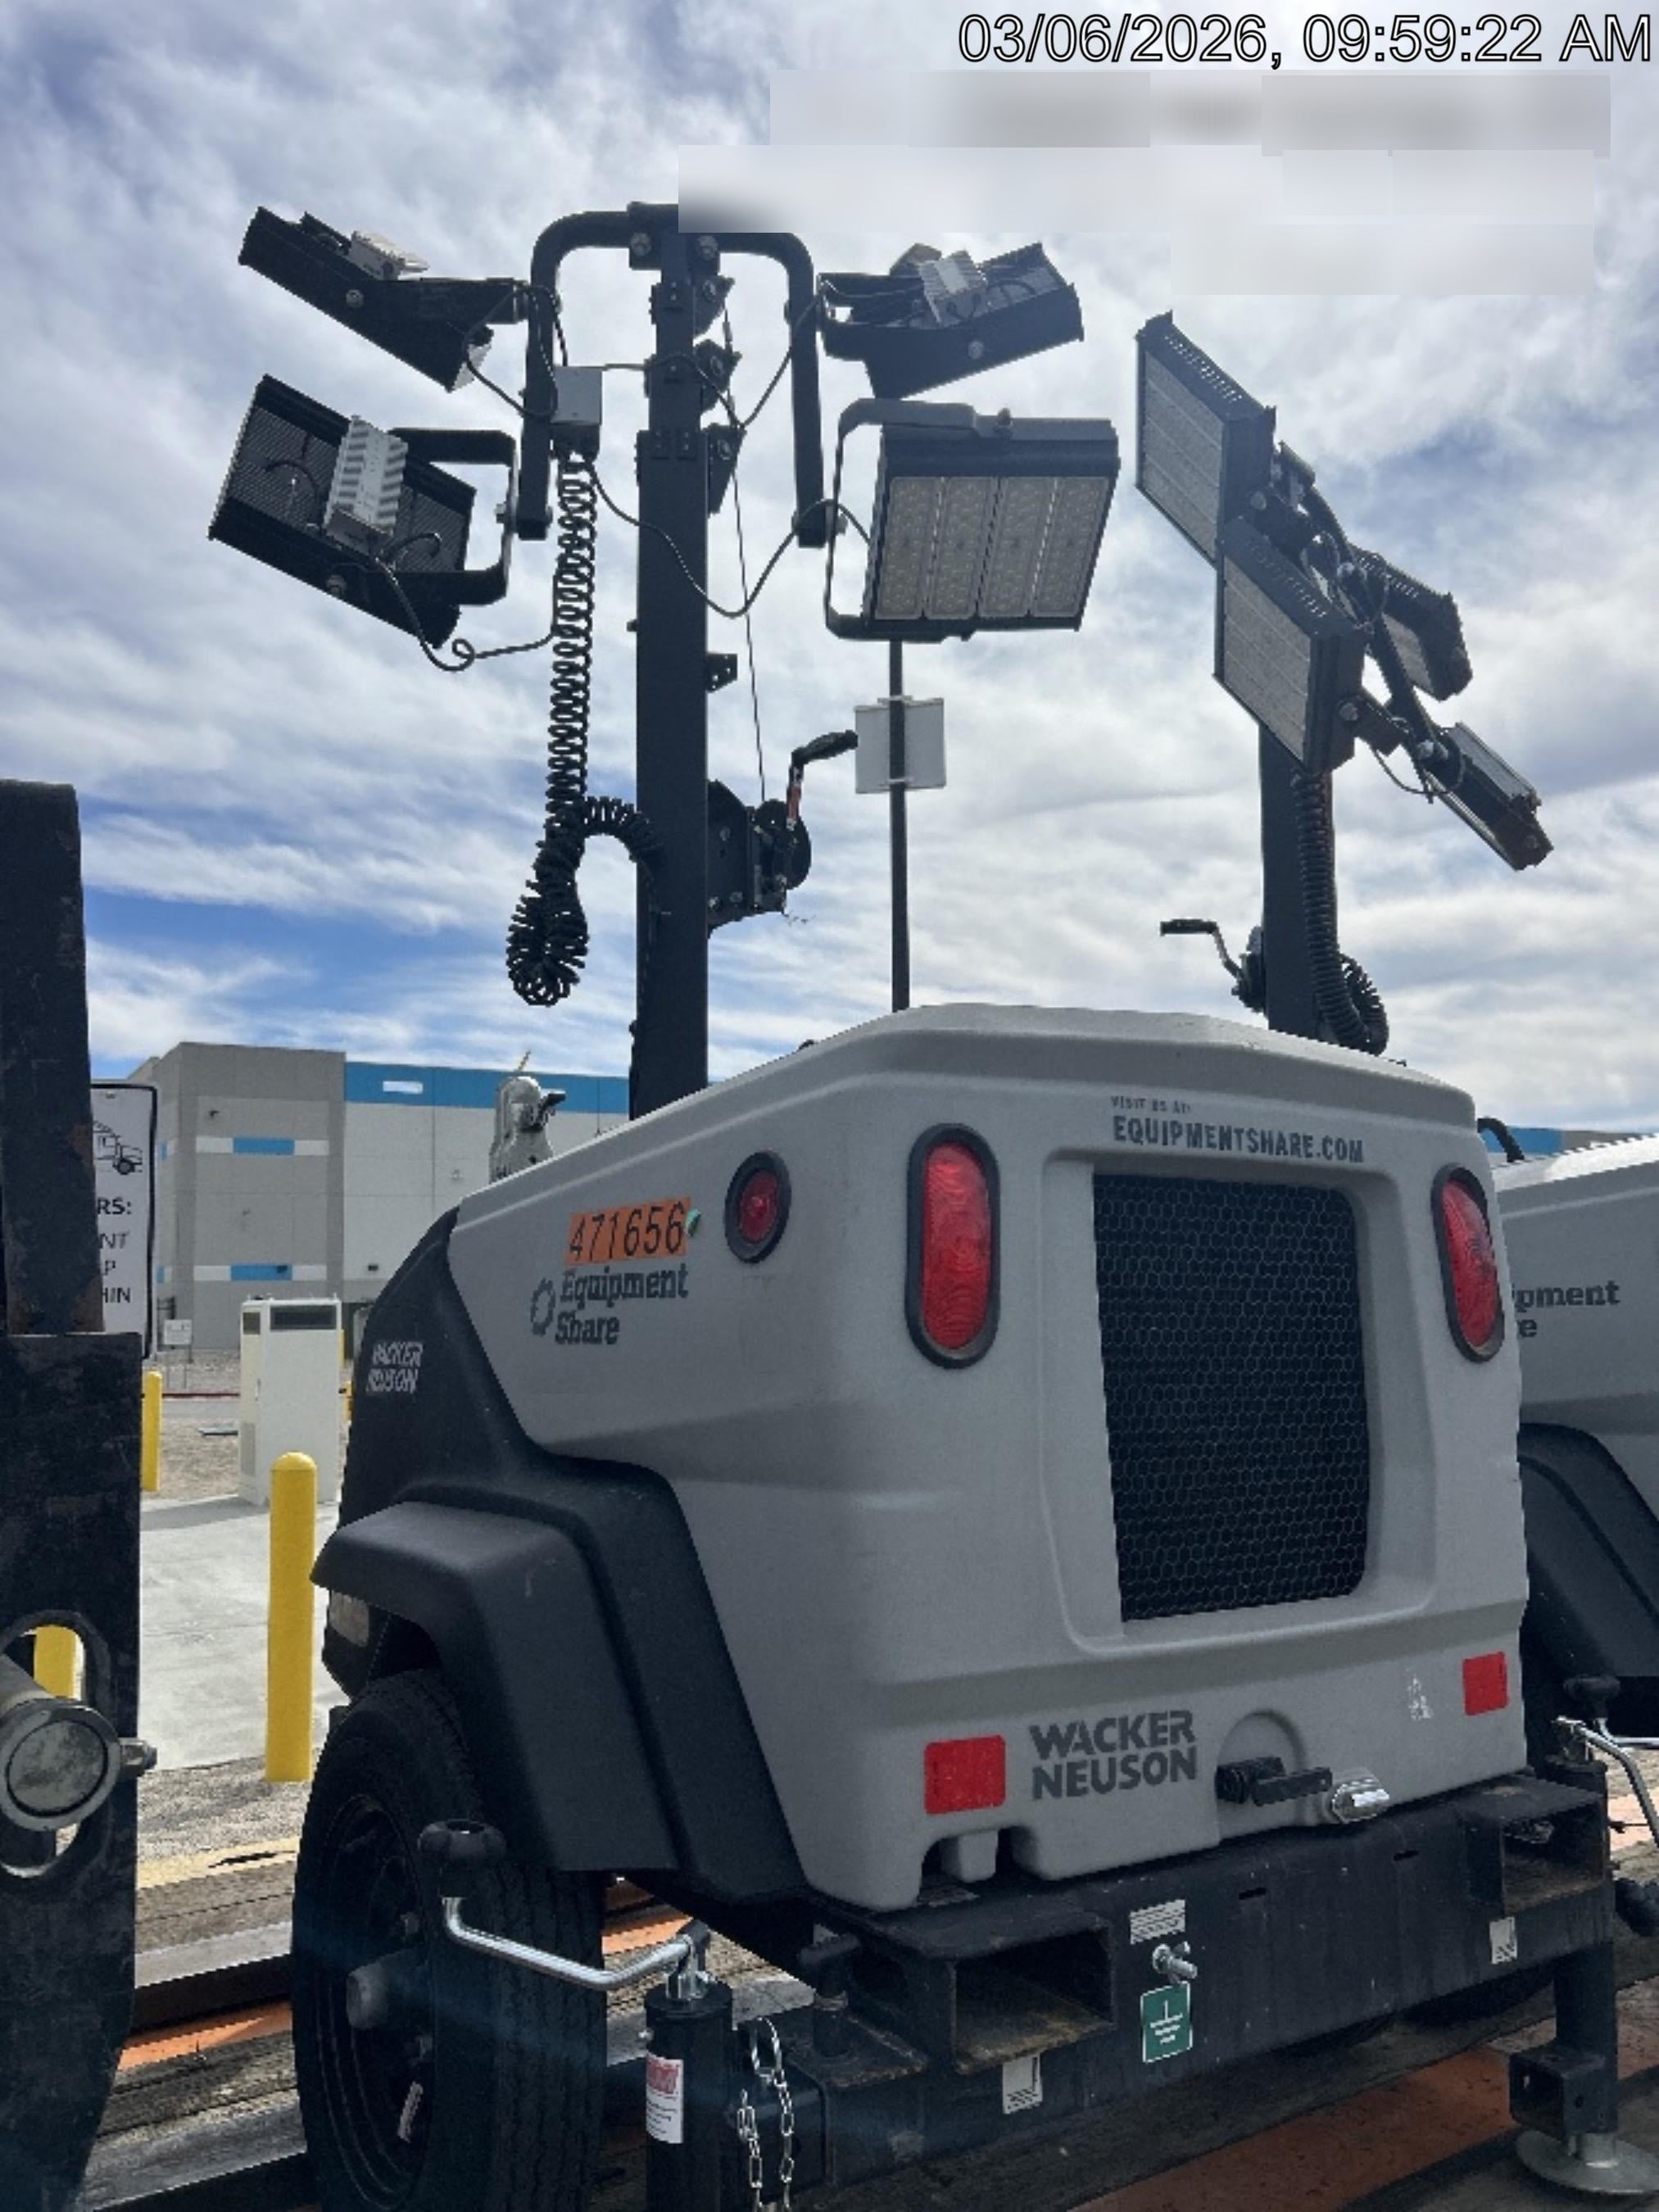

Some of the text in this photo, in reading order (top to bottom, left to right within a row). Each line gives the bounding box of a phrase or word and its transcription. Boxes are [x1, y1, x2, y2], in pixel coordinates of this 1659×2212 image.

[1113, 1115, 1365, 1163] EQUIPMENTSHARE.COM
[96, 1197, 132, 1215] RS:
[99, 1231, 130, 1249] NT
[569, 1201, 686, 1260] 471656
[560, 1262, 689, 1310] Equipment
[1512, 1280, 1620, 1312] pment
[555, 1310, 620, 1344] Share
[1029, 1710, 1196, 1760] WACKER
[1032, 1747, 1197, 1800] NEUSON
